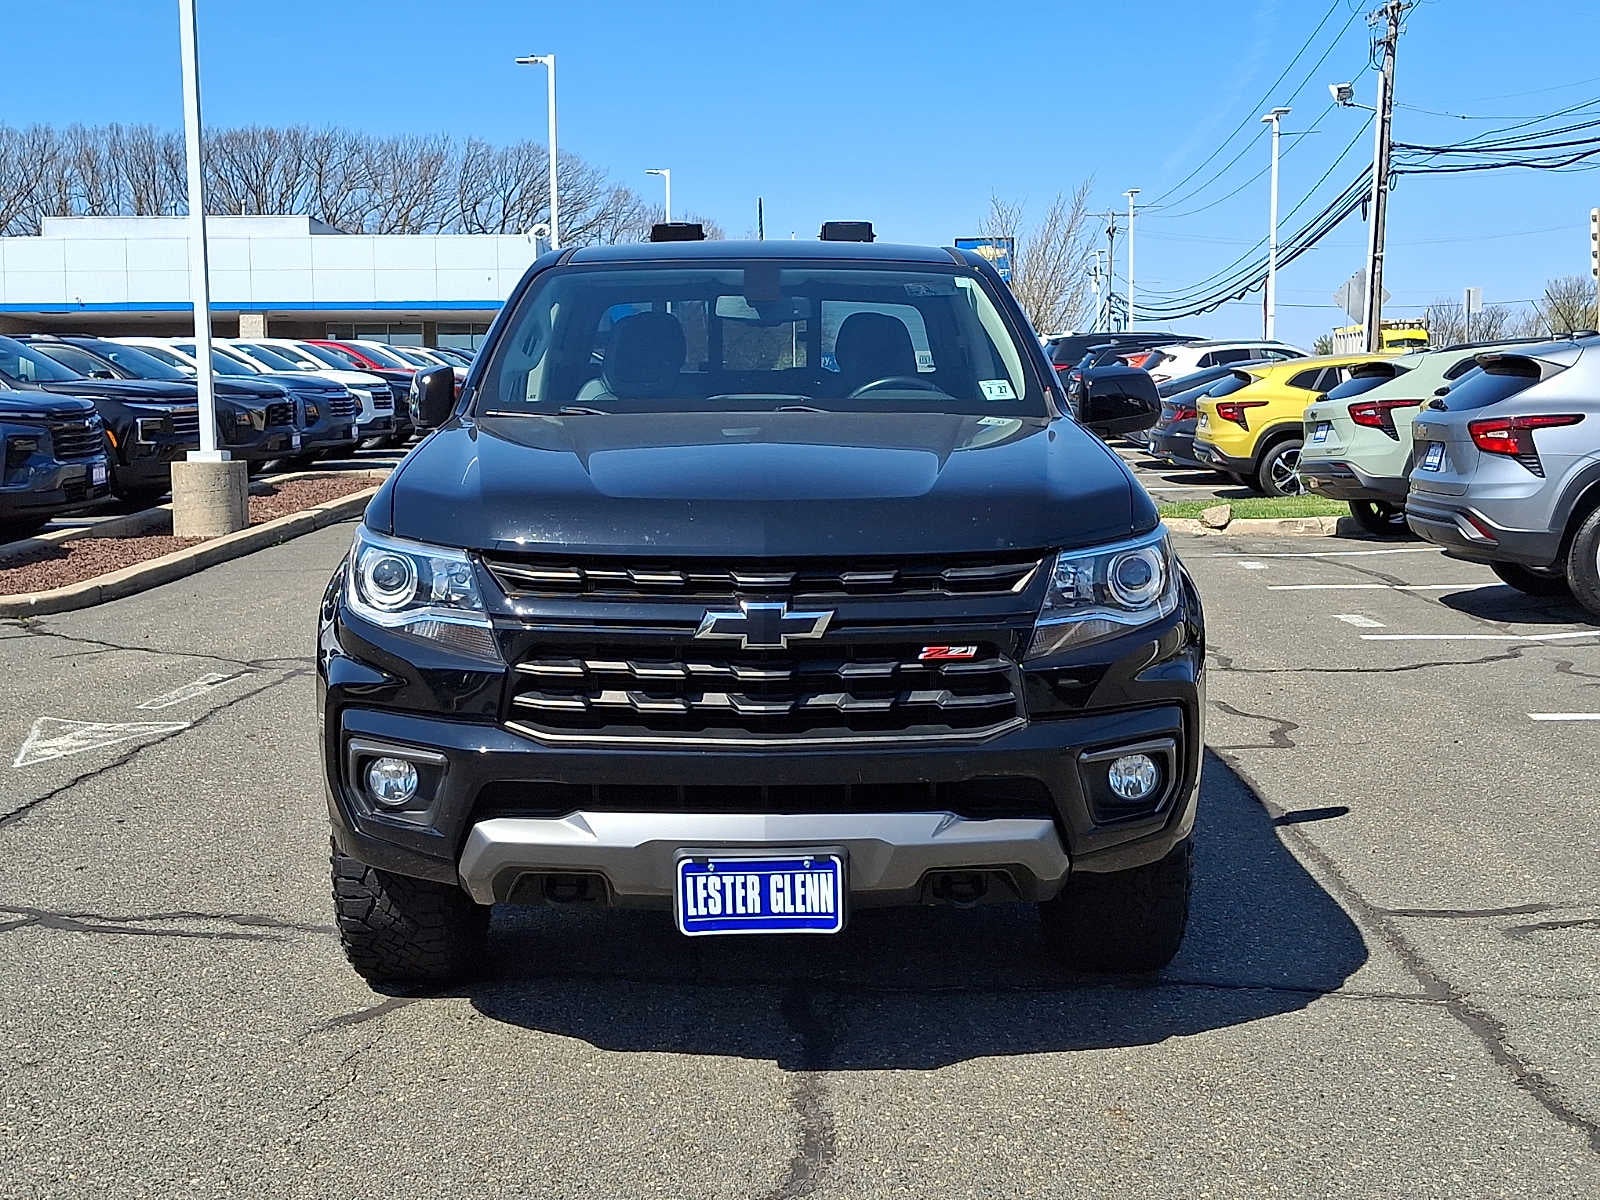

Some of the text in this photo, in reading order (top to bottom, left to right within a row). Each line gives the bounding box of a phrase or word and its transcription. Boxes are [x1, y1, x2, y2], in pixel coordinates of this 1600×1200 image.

[986, 385, 1008, 394] 7 27
[918, 645, 978, 660] Z71
[685, 872, 835, 916] LESTER GLENN
